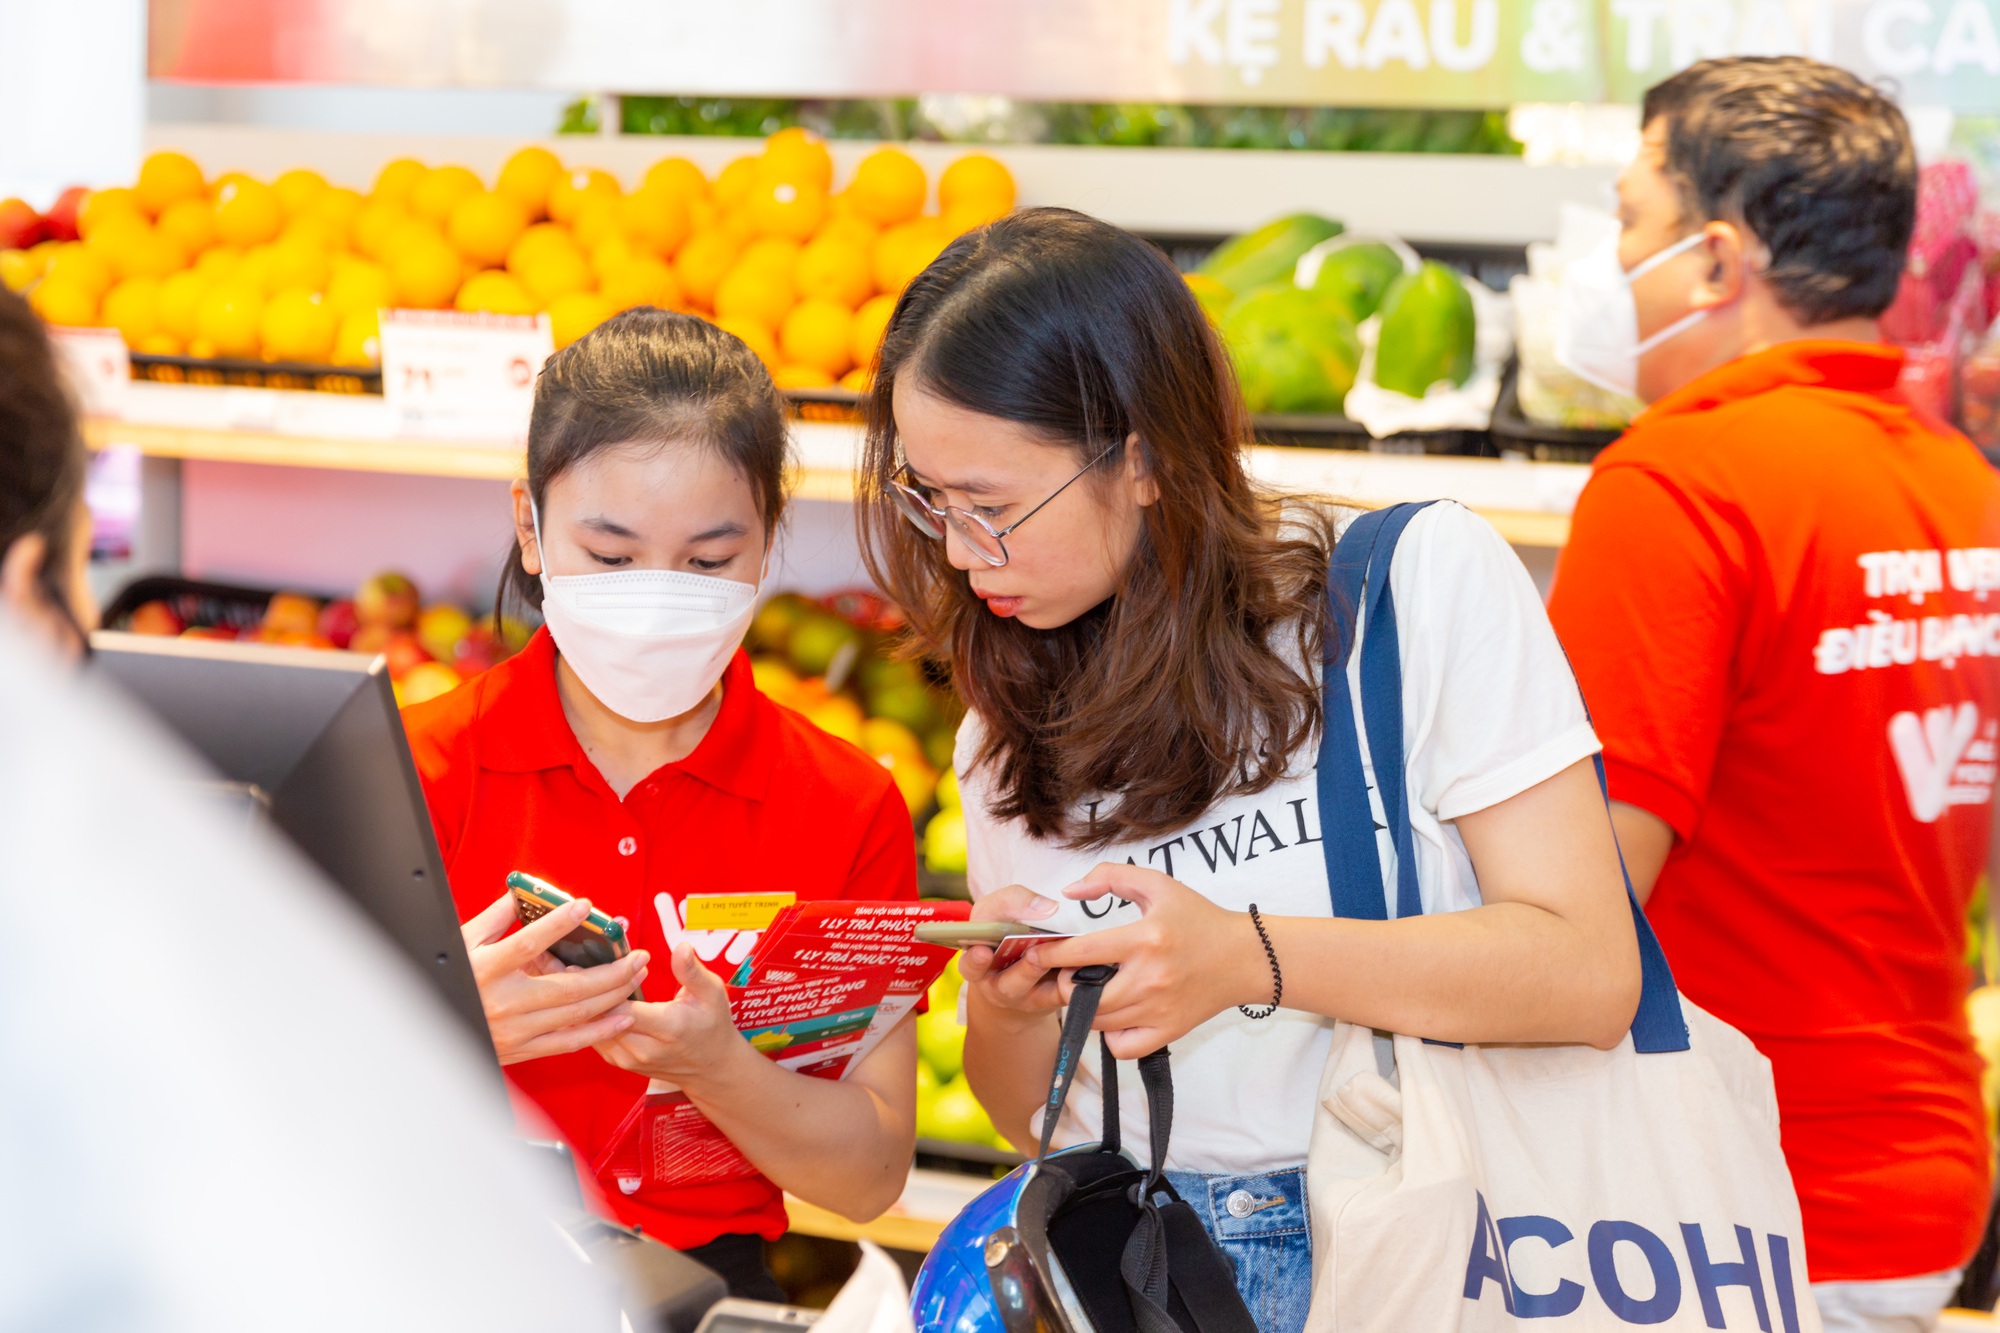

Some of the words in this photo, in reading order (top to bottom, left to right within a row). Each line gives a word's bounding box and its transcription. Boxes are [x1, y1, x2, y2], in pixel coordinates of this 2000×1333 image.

[1302, 0, 1499, 72] RAU
[1519, 0, 1585, 73] &
[1812, 609, 1918, 674] ĐIỀU
[1080, 786, 1388, 919] CATWAL
[827, 918, 848, 929] LY
[874, 917, 916, 931] PHÚC
[801, 951, 823, 961] LY
[850, 953, 891, 965] PHÚC
[773, 988, 822, 1006] PHÚC
[821, 979, 867, 997] LONG
